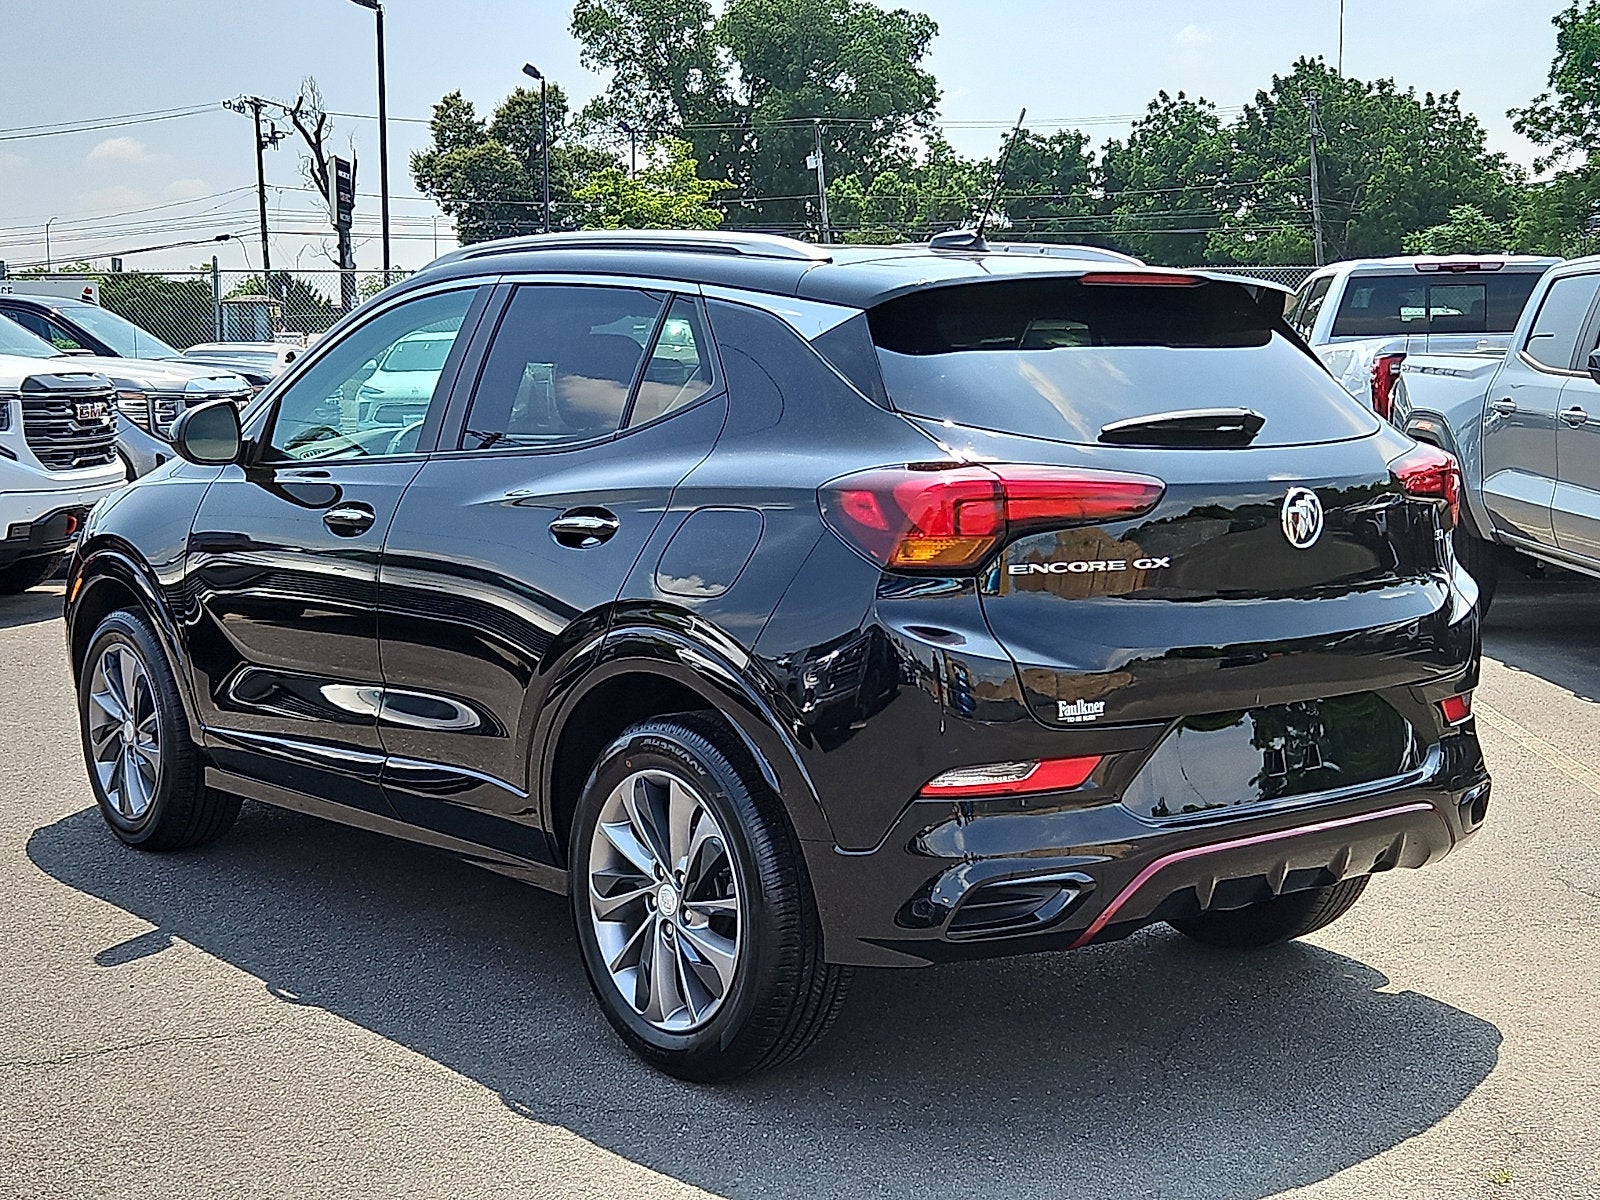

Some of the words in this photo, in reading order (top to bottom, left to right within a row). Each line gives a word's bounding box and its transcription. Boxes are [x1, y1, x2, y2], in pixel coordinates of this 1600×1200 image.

[1008, 560, 1126, 575] ENCORE
[1133, 557, 1170, 569] GX
[1057, 699, 1106, 717] Faulkner
